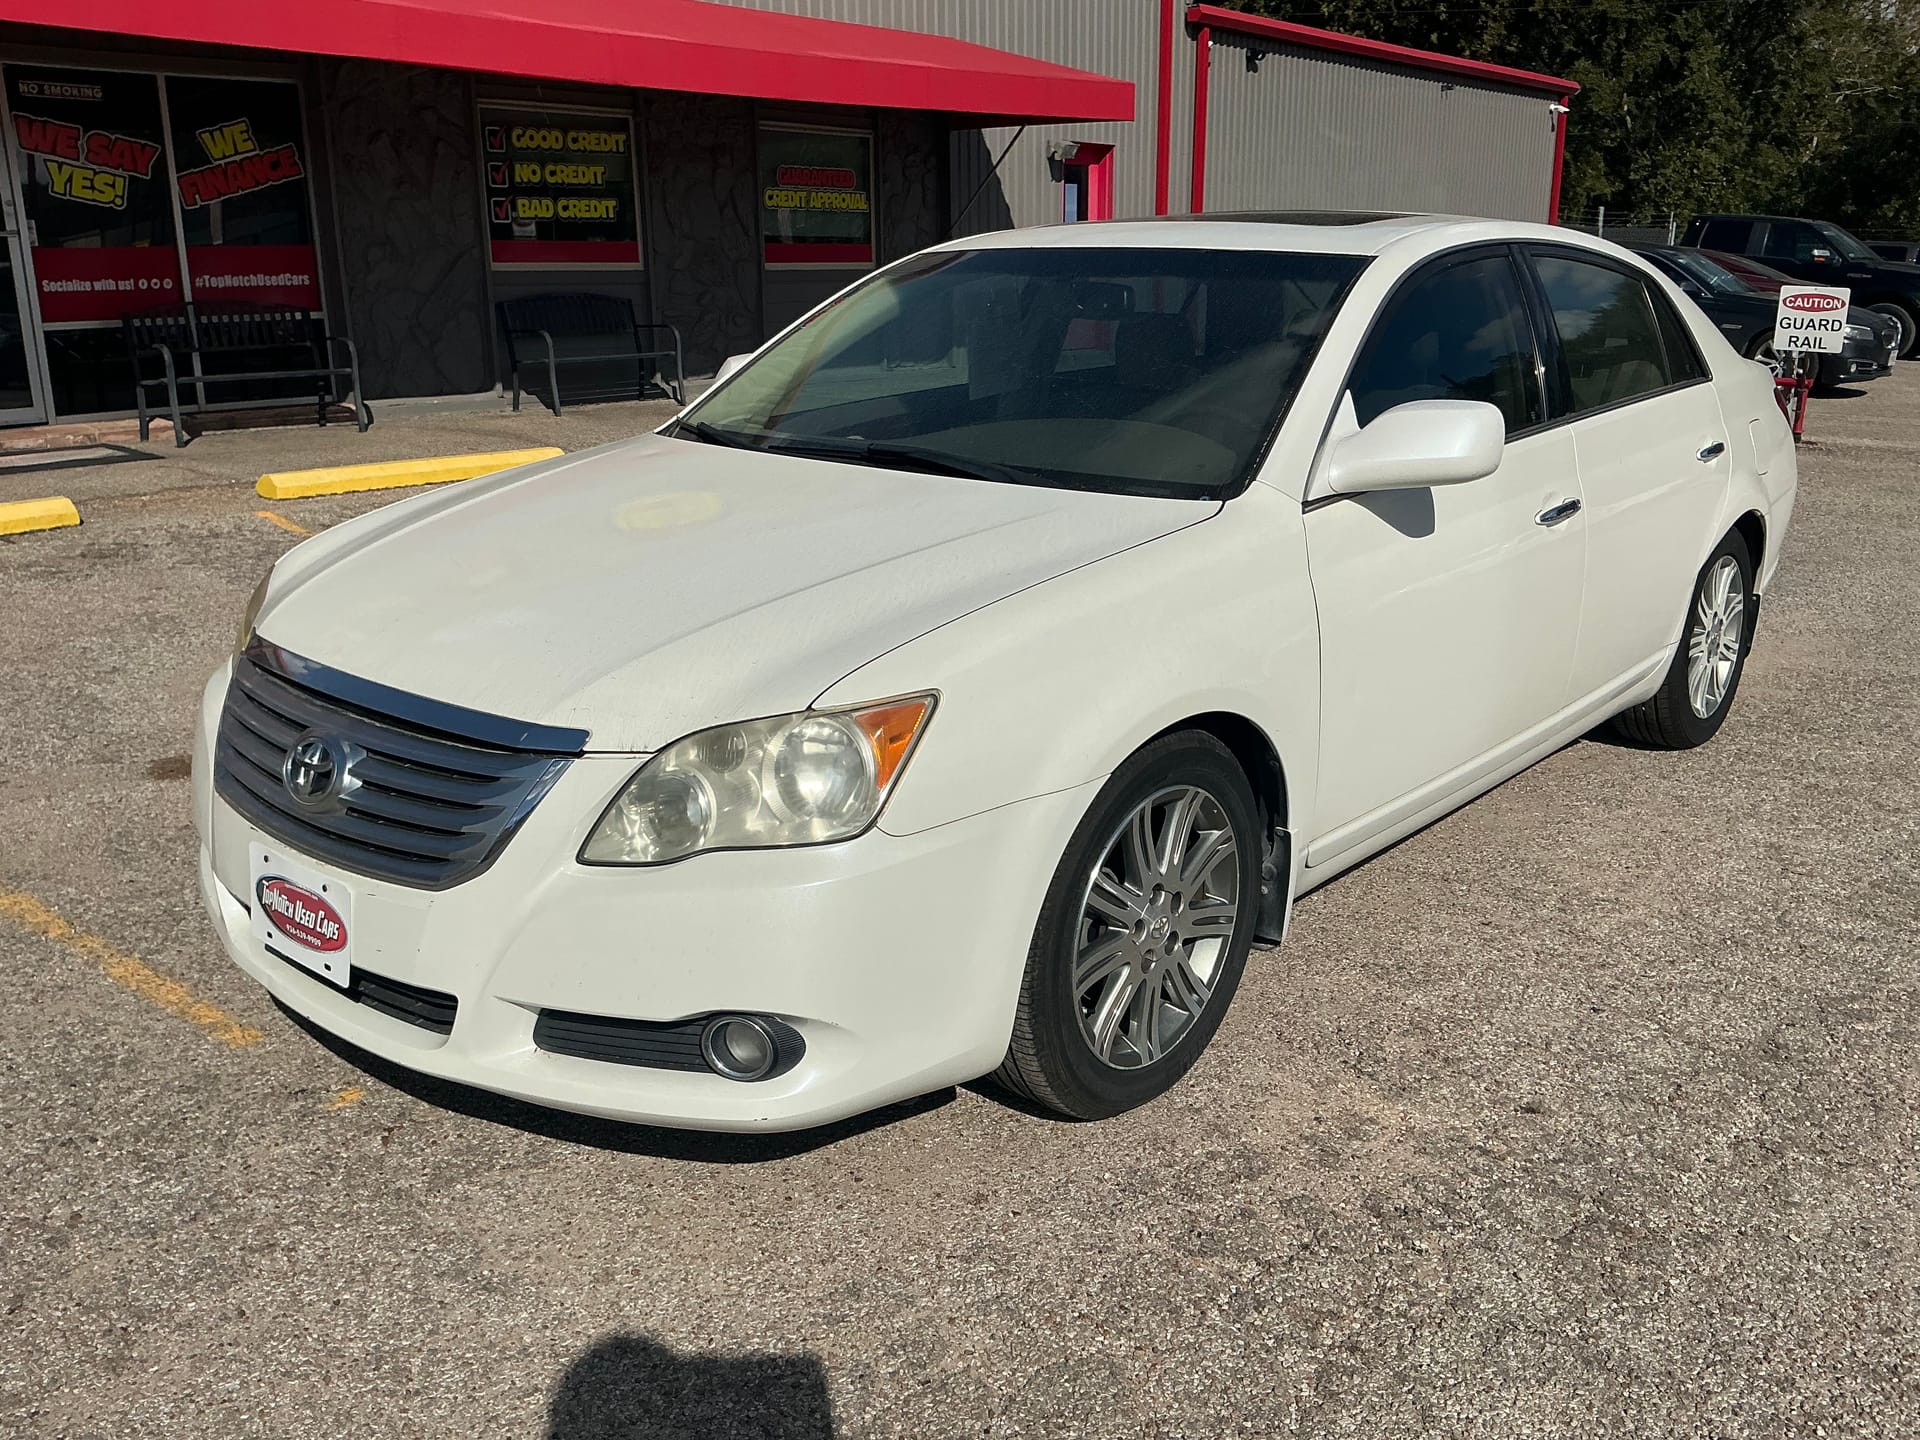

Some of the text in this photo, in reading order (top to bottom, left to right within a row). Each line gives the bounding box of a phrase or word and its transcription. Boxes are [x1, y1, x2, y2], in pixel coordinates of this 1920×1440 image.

[18, 83, 103, 98] NO SMOKING
[13, 113, 160, 177] WE SAY
[199, 121, 256, 160] WE
[511, 128, 627, 153] GOOD CREDIT
[44, 160, 125, 206] YES!
[177, 145, 303, 207] FINANCE
[513, 162, 605, 186] NO CREDIT
[778, 166, 855, 189] GUARANTEED
[516, 198, 617, 220] BAD CREDIT
[764, 190, 869, 210] CREDIT APPROVAL
[41, 278, 135, 293] Socialize with us!
[194, 273, 310, 288] #TopNotchUsedCars
[1785, 296, 1842, 310] CAUTION
[1779, 316, 1843, 332] GUARD
[1787, 335, 1828, 350] RAIL
